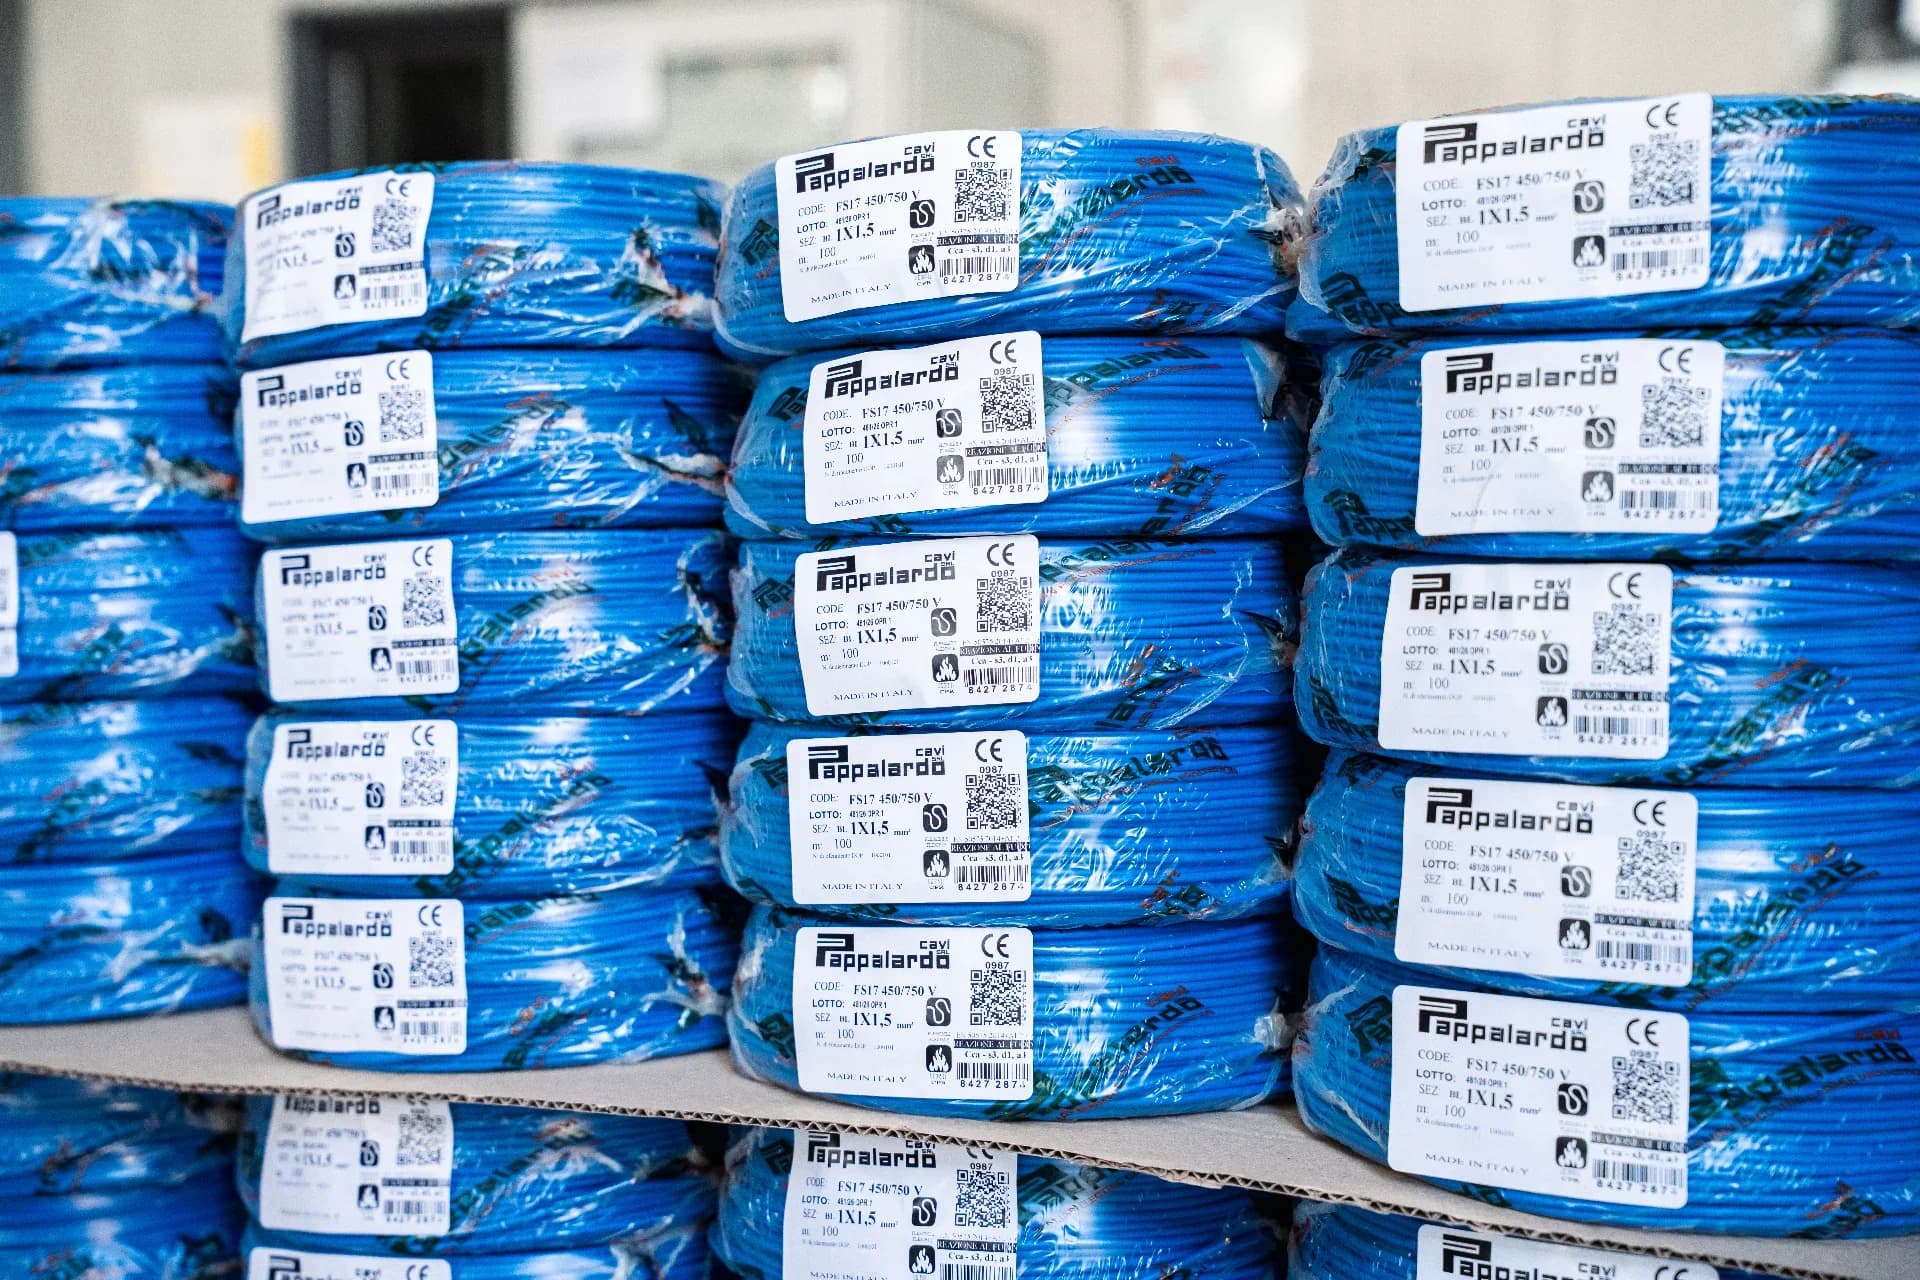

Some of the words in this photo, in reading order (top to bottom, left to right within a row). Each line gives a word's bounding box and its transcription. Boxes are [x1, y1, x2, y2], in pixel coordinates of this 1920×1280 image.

[1567, 115, 1606, 128] cavi
[1646, 102, 1680, 129] CE
[904, 142, 935, 157] cavi
[967, 136, 996, 158] CE
[1424, 122, 1604, 165] Pappalardo
[795, 152, 934, 194] Pappalardo
[970, 161, 996, 169] 0987
[1477, 175, 1511, 190] FS17
[1515, 170, 1570, 186] 450/750
[836, 197, 861, 213] FS17
[864, 191, 908, 207] 450/750
[912, 190, 919, 200] V
[1421, 198, 1467, 211] LOTTO:
[837, 222, 874, 242] 1X1,5
[1456, 230, 1480, 244] 100
[820, 246, 836, 259] 100
[811, 292, 841, 304] MADE
[930, 350, 960, 365] cavi
[989, 339, 1017, 364] CE
[1580, 352, 1619, 364] cavi
[1658, 347, 1693, 374] CE
[386, 358, 409, 381] CE
[993, 366, 1018, 376] 0987
[1446, 352, 1617, 395] Pappalardo
[824, 360, 958, 399] Pappalardo
[257, 374, 361, 408] Pappalardo
[862, 405, 889, 419] FS17
[892, 400, 934, 415] 450/750
[937, 398, 944, 408] V
[1491, 406, 1523, 420] FS17
[1528, 405, 1583, 418] 450/750
[821, 426, 855, 438] LOTTO:
[864, 430, 903, 449] 1X1,5
[1442, 427, 1480, 439] LOTTO:
[847, 452, 864, 465] 100
[1471, 458, 1491, 471] 100
[412, 545, 434, 567] CE
[924, 550, 955, 563] cavi
[987, 543, 1015, 566] CE
[280, 554, 386, 586] Pappalardo
[816, 554, 955, 593] Pappalardo
[991, 569, 1015, 578] 0987
[1534, 578, 1571, 591] cavi
[1608, 572, 1642, 599] CE
[1410, 573, 1569, 615] Pappalardo
[857, 602, 882, 614] FS17
[885, 598, 929, 611] 450/750
[932, 597, 941, 607] V
[815, 620, 849, 631] LOTTO:
[858, 627, 897, 644] 1X1,5
[1449, 628, 1480, 641] FS17
[1484, 629, 1537, 641] 450/750
[1541, 630, 1551, 641] V
[842, 647, 859, 659] 100
[1402, 645, 1439, 655] LOTTO:
[1450, 659, 1495, 676] 1X1,5
[1429, 677, 1449, 689] 100
[411, 725, 435, 747] CE
[915, 745, 945, 757] cavi
[975, 738, 1003, 763] CE
[808, 745, 945, 783] Pappalardo
[979, 765, 1003, 774] 0987
[849, 794, 875, 805] FS17
[878, 792, 921, 804] 450/750
[924, 792, 933, 803] V
[1556, 800, 1594, 813] cavi
[809, 810, 842, 820] LOTTO:
[1426, 787, 1593, 834] Pappalardo
[1633, 799, 1666, 827] CE
[851, 820, 889, 836] 1X1,5
[834, 838, 852, 849] 100
[1470, 845, 1502, 858] FS17
[1506, 848, 1558, 863] 450/750
[1564, 852, 1574, 863] V
[1422, 859, 1459, 870] LOTTO:
[1470, 876, 1517, 894] 1X1,5
[1448, 892, 1469, 906] 100
[282, 904, 392, 937] Pappalardo
[418, 905, 441, 927] CE
[816, 933, 950, 972] Pappalardo
[919, 939, 950, 950] cavi
[981, 934, 1009, 958] CE
[985, 961, 1009, 970] 0987
[854, 984, 879, 995] FS17
[881, 985, 925, 996] 450/750
[928, 986, 937, 996] V
[812, 999, 845, 1008] LOTTO:
[854, 1012, 892, 1028] 1X1,5
[1418, 995, 1587, 1052] Pappalardo
[1551, 1017, 1588, 1030] cavi
[838, 1029, 855, 1039] 100
[1626, 1018, 1658, 1047] CE
[1416, 1068, 1456, 1082] LOTTO:
[1467, 1057, 1498, 1072] FS17
[1502, 1063, 1554, 1080] 450/750
[1560, 1069, 1571, 1081] V
[1467, 1088, 1513, 1109] 1X1,5
[1445, 1105, 1466, 1118] 100
[808, 1130, 937, 1168] Pappalardo
[970, 1162, 993, 1171] 0987
[837, 1181, 865, 1193] FS17
[868, 1183, 910, 1196] 450/750
[914, 1185, 923, 1195] V
[801, 1195, 830, 1205] LOTTO:
[839, 1209, 876, 1226] 1X1,5
[822, 1226, 839, 1237] 100
[1578, 1262, 1616, 1278] cavi
